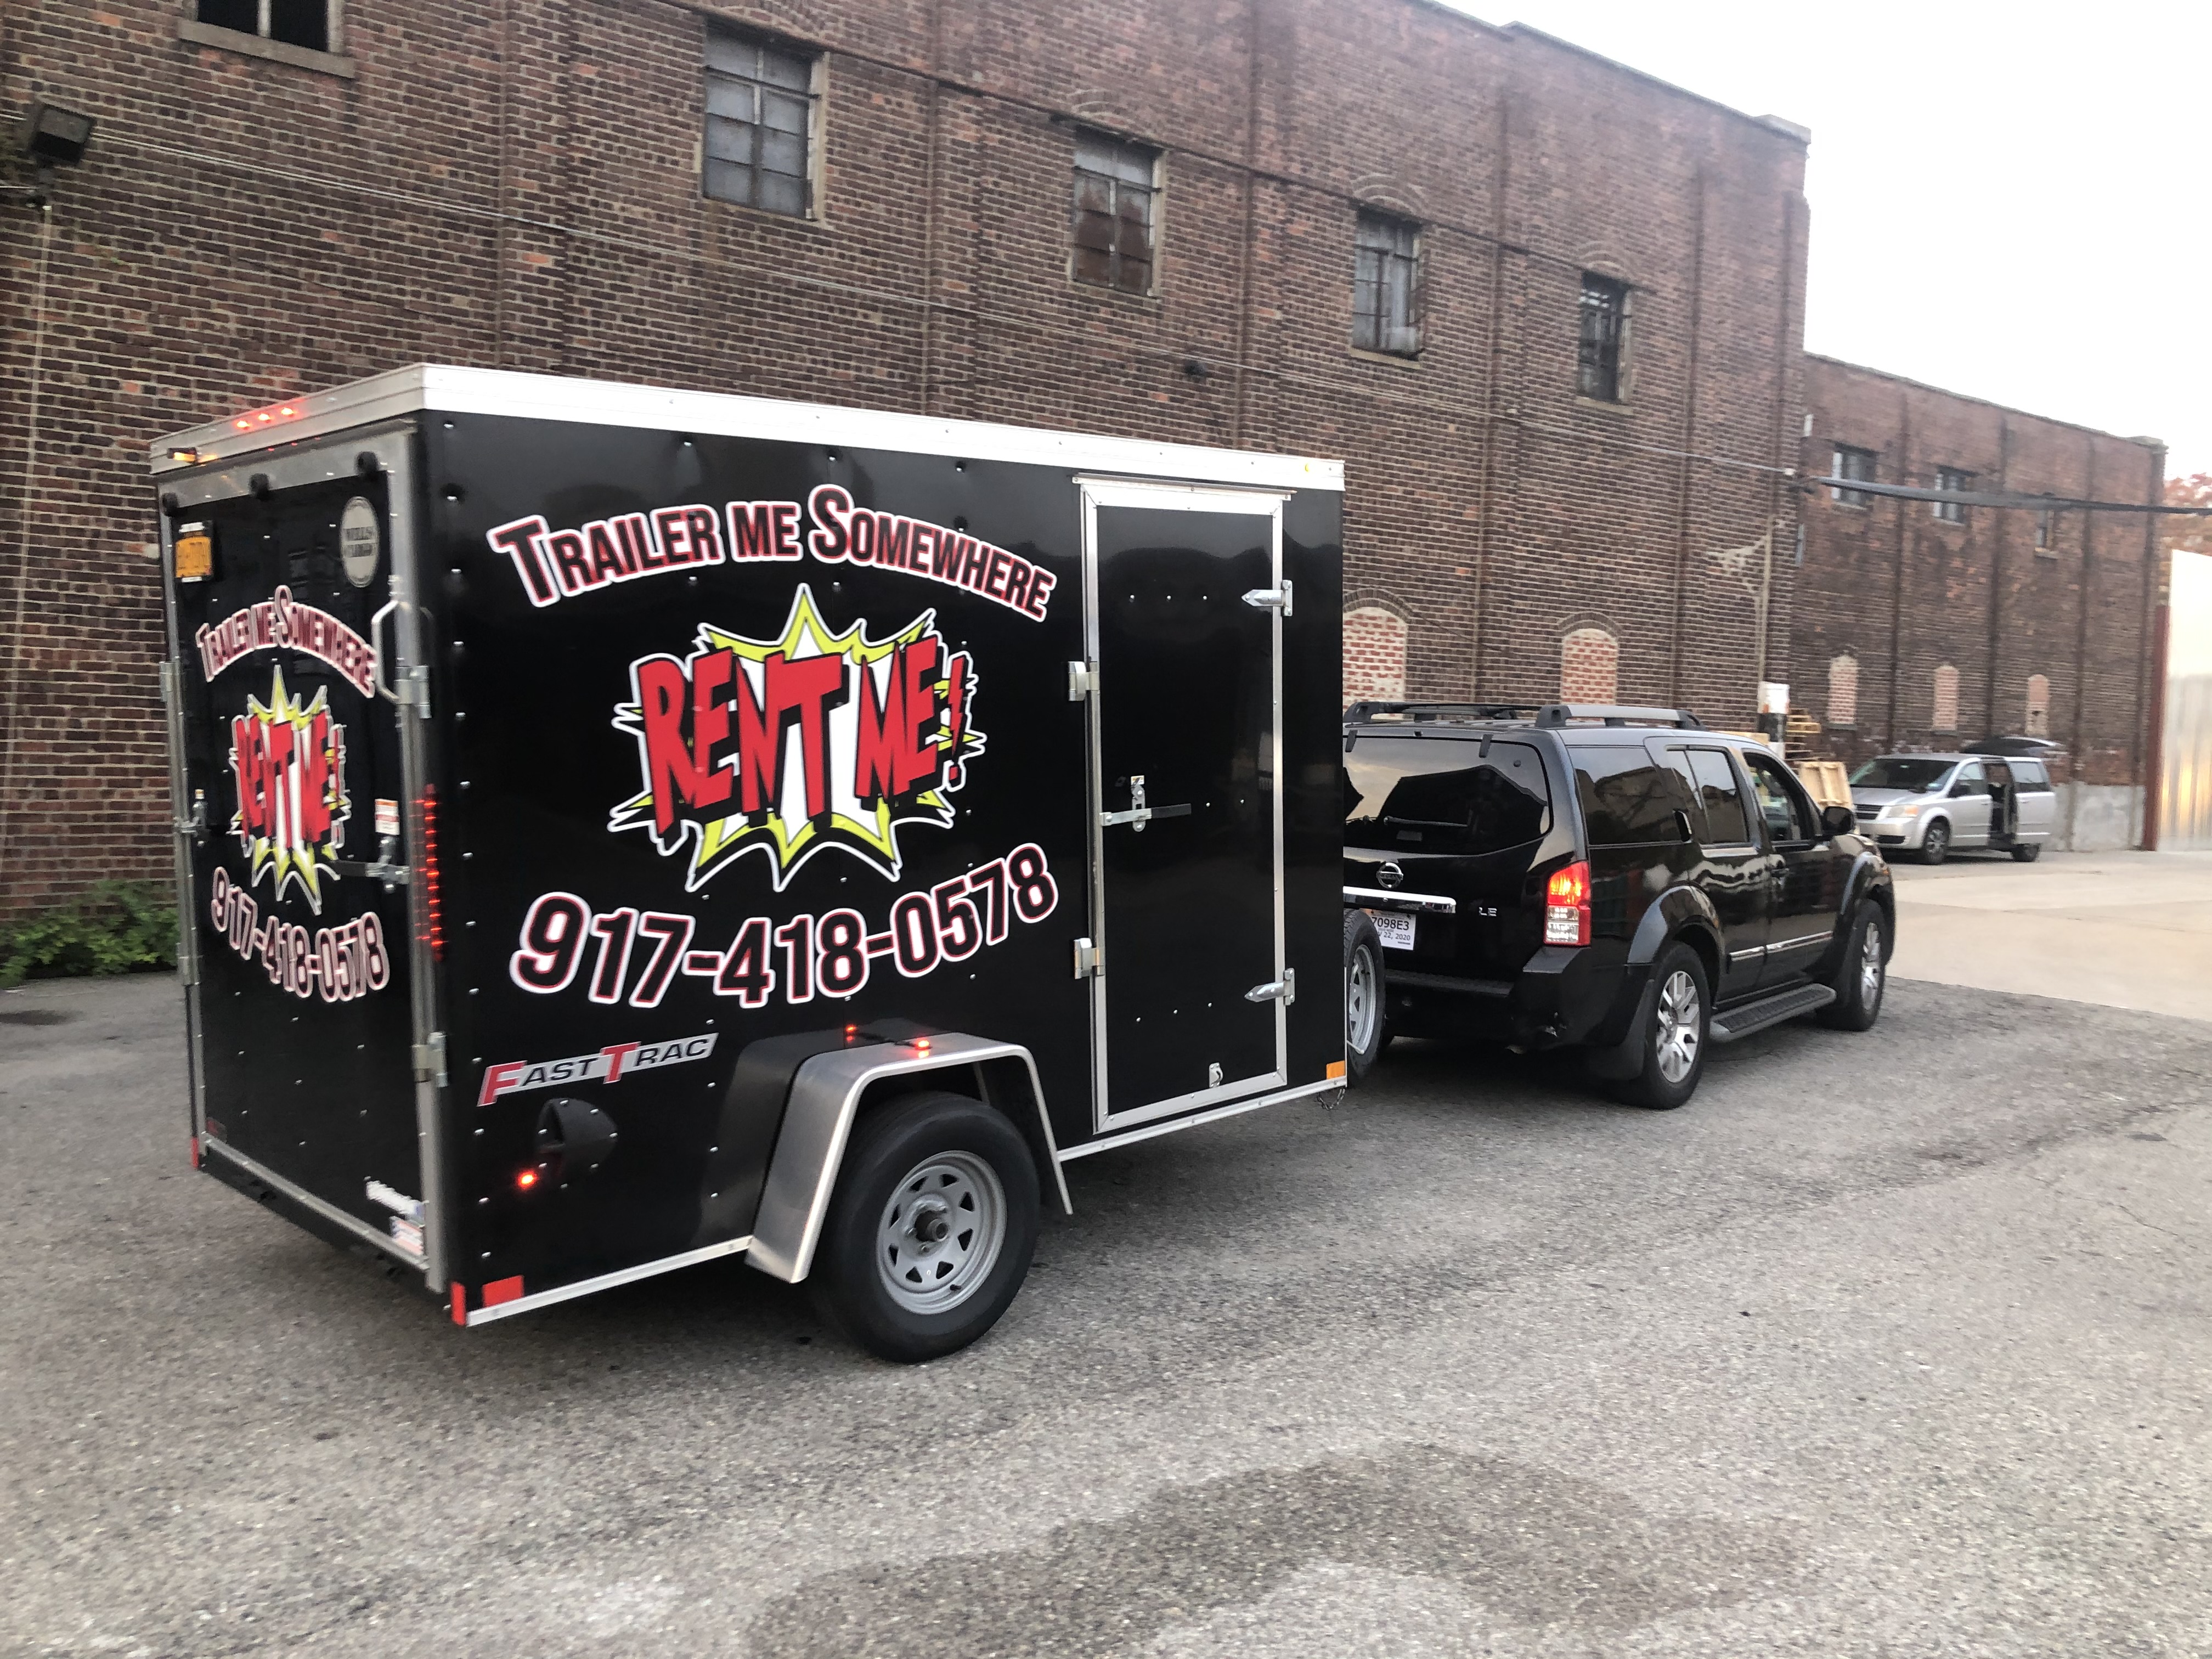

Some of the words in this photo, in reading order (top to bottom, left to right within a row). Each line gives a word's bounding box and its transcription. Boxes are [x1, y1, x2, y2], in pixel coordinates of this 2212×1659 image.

[487, 504, 725, 606] TRAILER
[726, 501, 802, 562] ME
[808, 484, 1057, 622] SOMEWHERE
[234, 714, 295, 854] RENT
[636, 646, 851, 839] RENT
[211, 867, 390, 1002] 917-418-0578
[510, 843, 1058, 1008] 917-418-0578
[1395, 933, 1411, 941] 2020
[1479, 907, 1498, 917] LE
